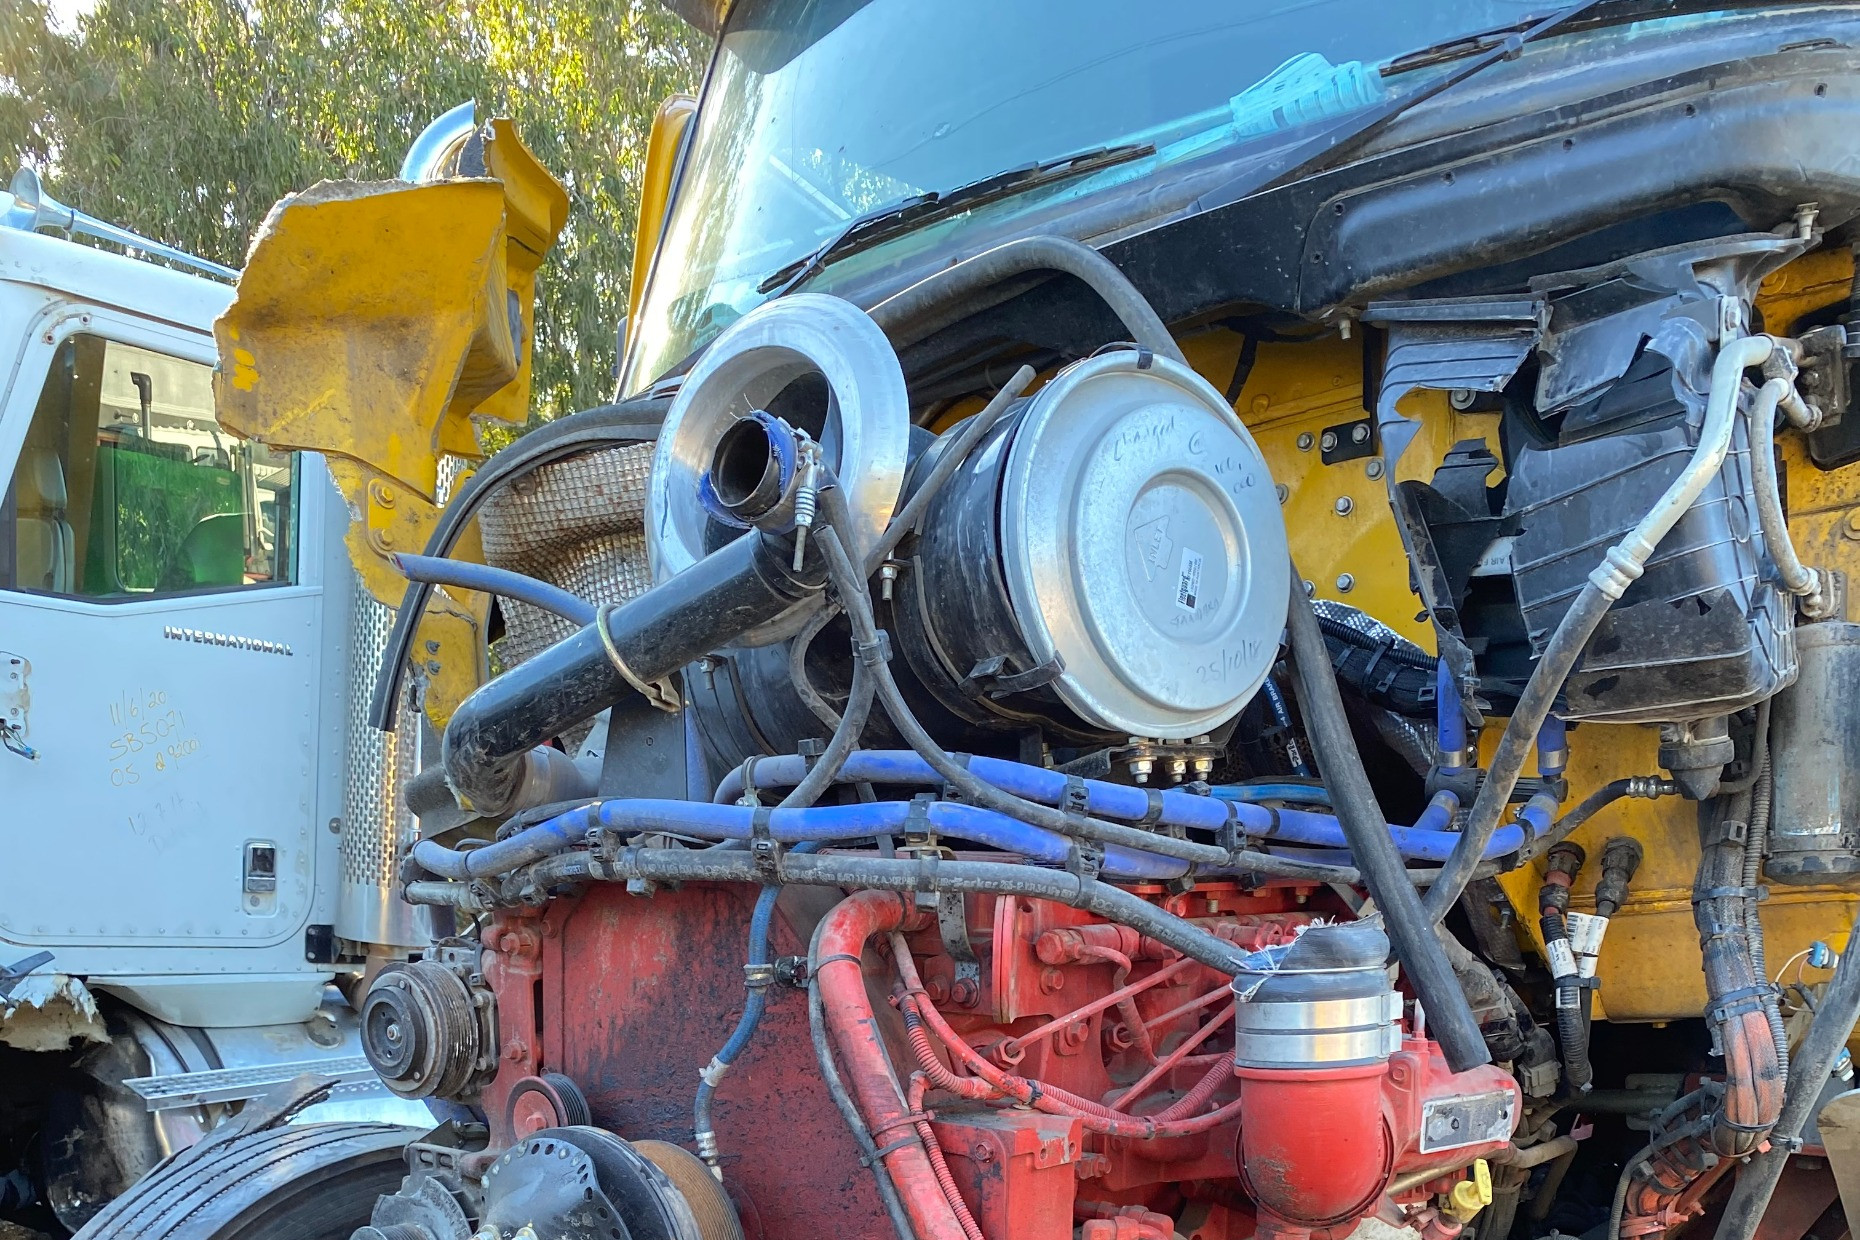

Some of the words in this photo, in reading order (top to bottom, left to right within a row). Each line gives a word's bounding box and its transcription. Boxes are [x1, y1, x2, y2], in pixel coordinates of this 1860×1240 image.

[1148, 526, 1164, 563] INLET
[1491, 557, 1506, 566] AIR
[163, 625, 294, 657] INTERNATIONAL
[1275, 701, 1285, 714] AIR
